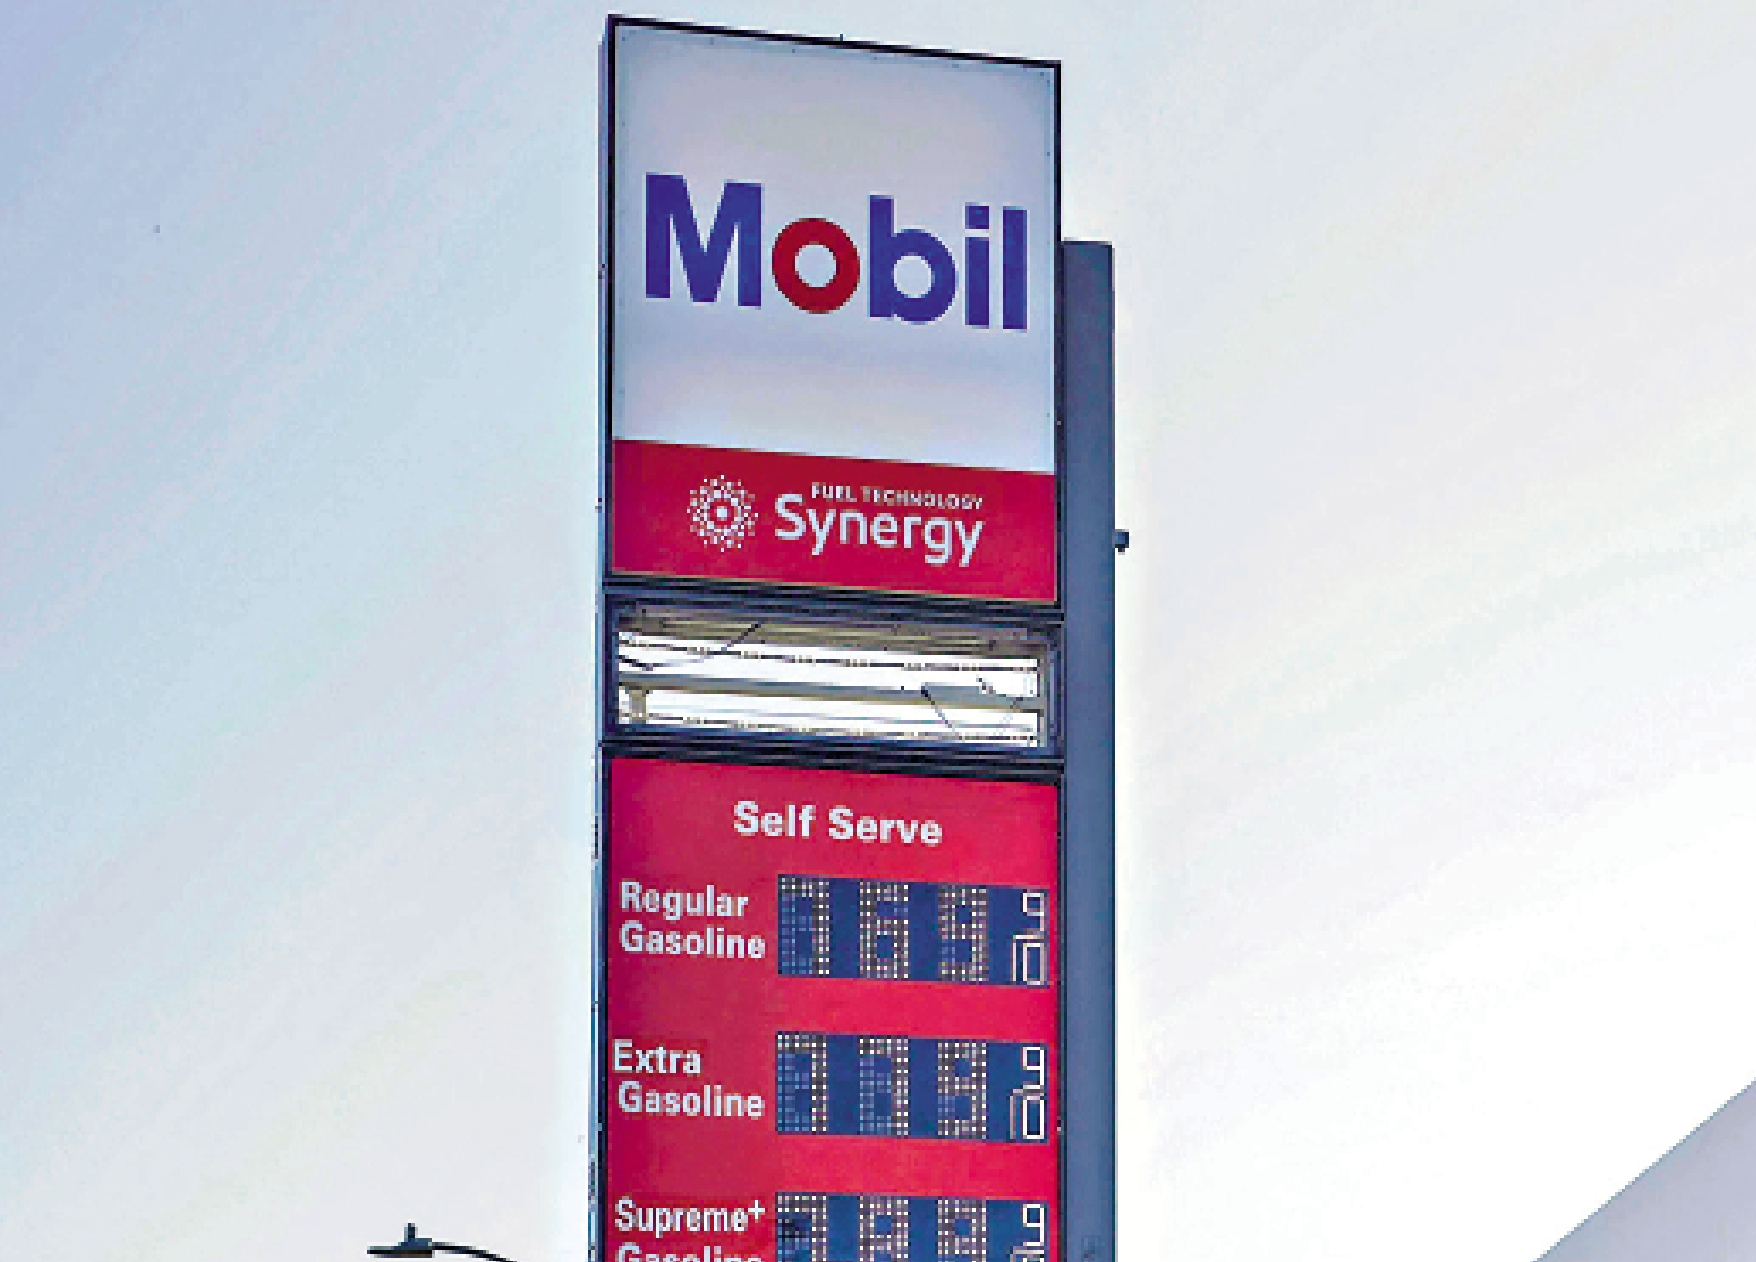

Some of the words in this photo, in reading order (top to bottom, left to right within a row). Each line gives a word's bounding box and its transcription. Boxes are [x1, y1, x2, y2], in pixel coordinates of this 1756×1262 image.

[645, 171, 1029, 332] Mobil
[811, 481, 857, 502] FUEL
[862, 484, 984, 510] TECHNOLOGY
[775, 493, 985, 567] Synergy
[733, 800, 815, 838] Self
[827, 807, 943, 845] Serve
[620, 881, 749, 920] Regular
[620, 921, 767, 959] Gasoline
[612, 1038, 702, 1075] Extra
[618, 1080, 766, 1118] Gasoline
